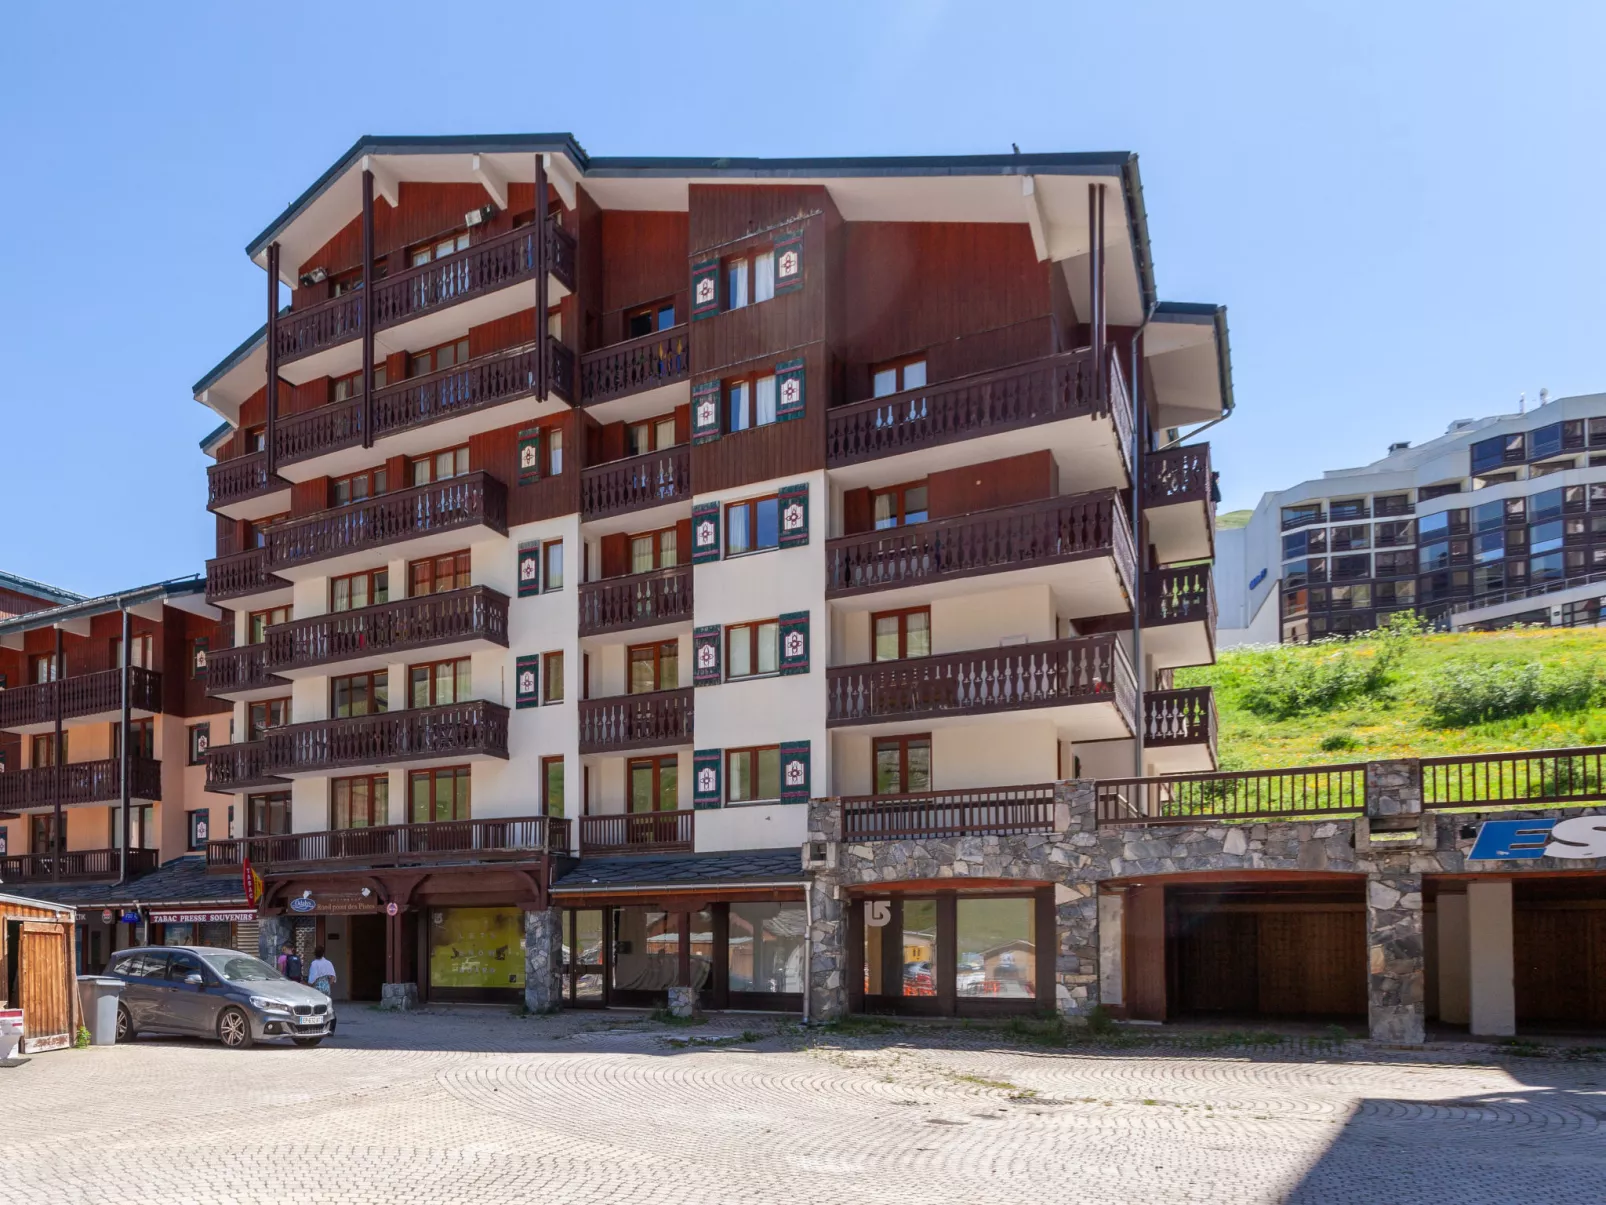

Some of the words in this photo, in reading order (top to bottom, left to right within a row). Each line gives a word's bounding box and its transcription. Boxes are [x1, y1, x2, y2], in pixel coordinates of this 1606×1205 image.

[246, 867, 254, 899] TABAC
[347, 902, 358, 910] des
[153, 915, 178, 923] TABAC
[209, 913, 253, 921] SOUVENIRS
